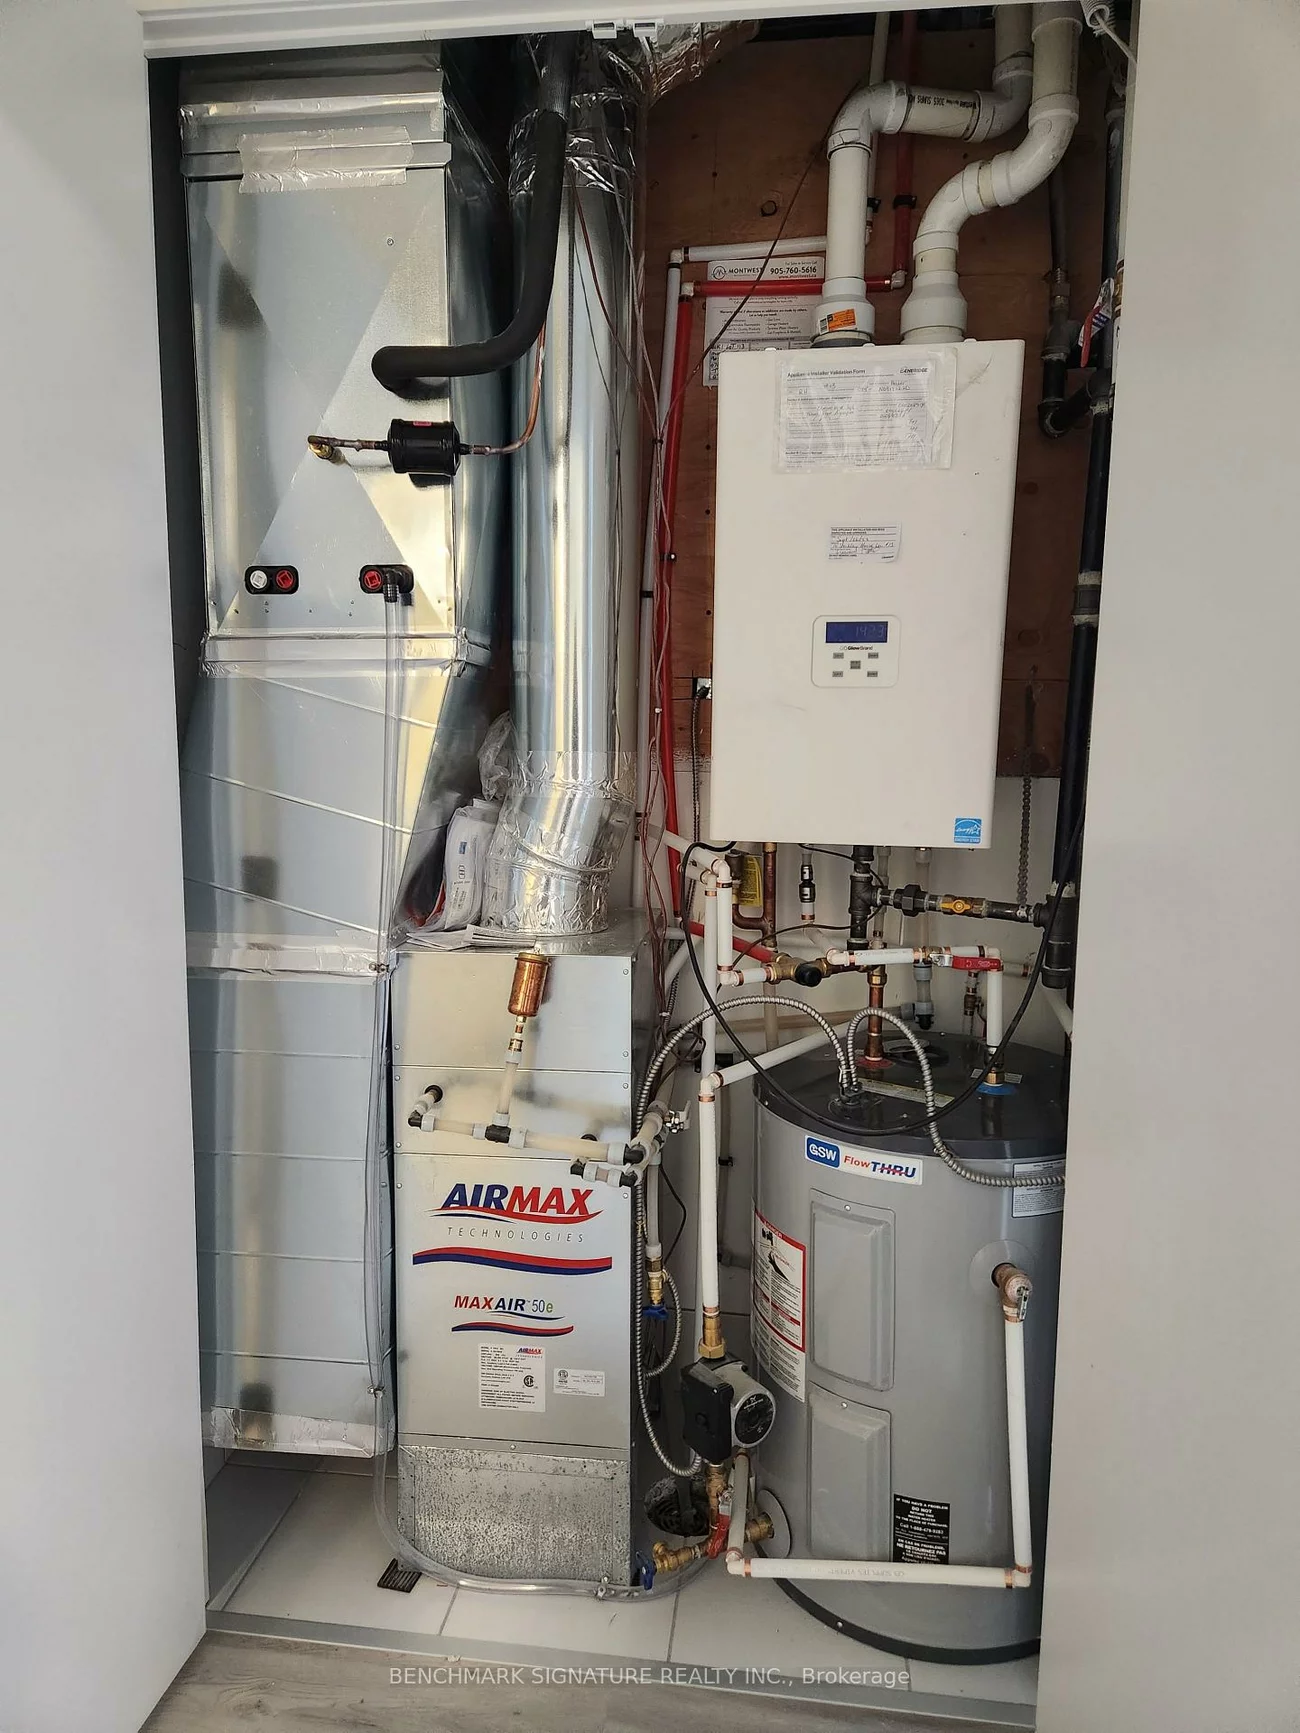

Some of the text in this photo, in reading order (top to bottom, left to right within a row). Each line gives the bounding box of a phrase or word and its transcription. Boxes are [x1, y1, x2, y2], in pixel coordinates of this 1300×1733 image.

[770, 266, 816, 275] 905-760-5616
[809, 1143, 836, 1161] GSW
[441, 1183, 593, 1215] AIRMAX
[447, 1226, 584, 1242] TECHNOLOGIES
[532, 1300, 553, 1313] 50e
